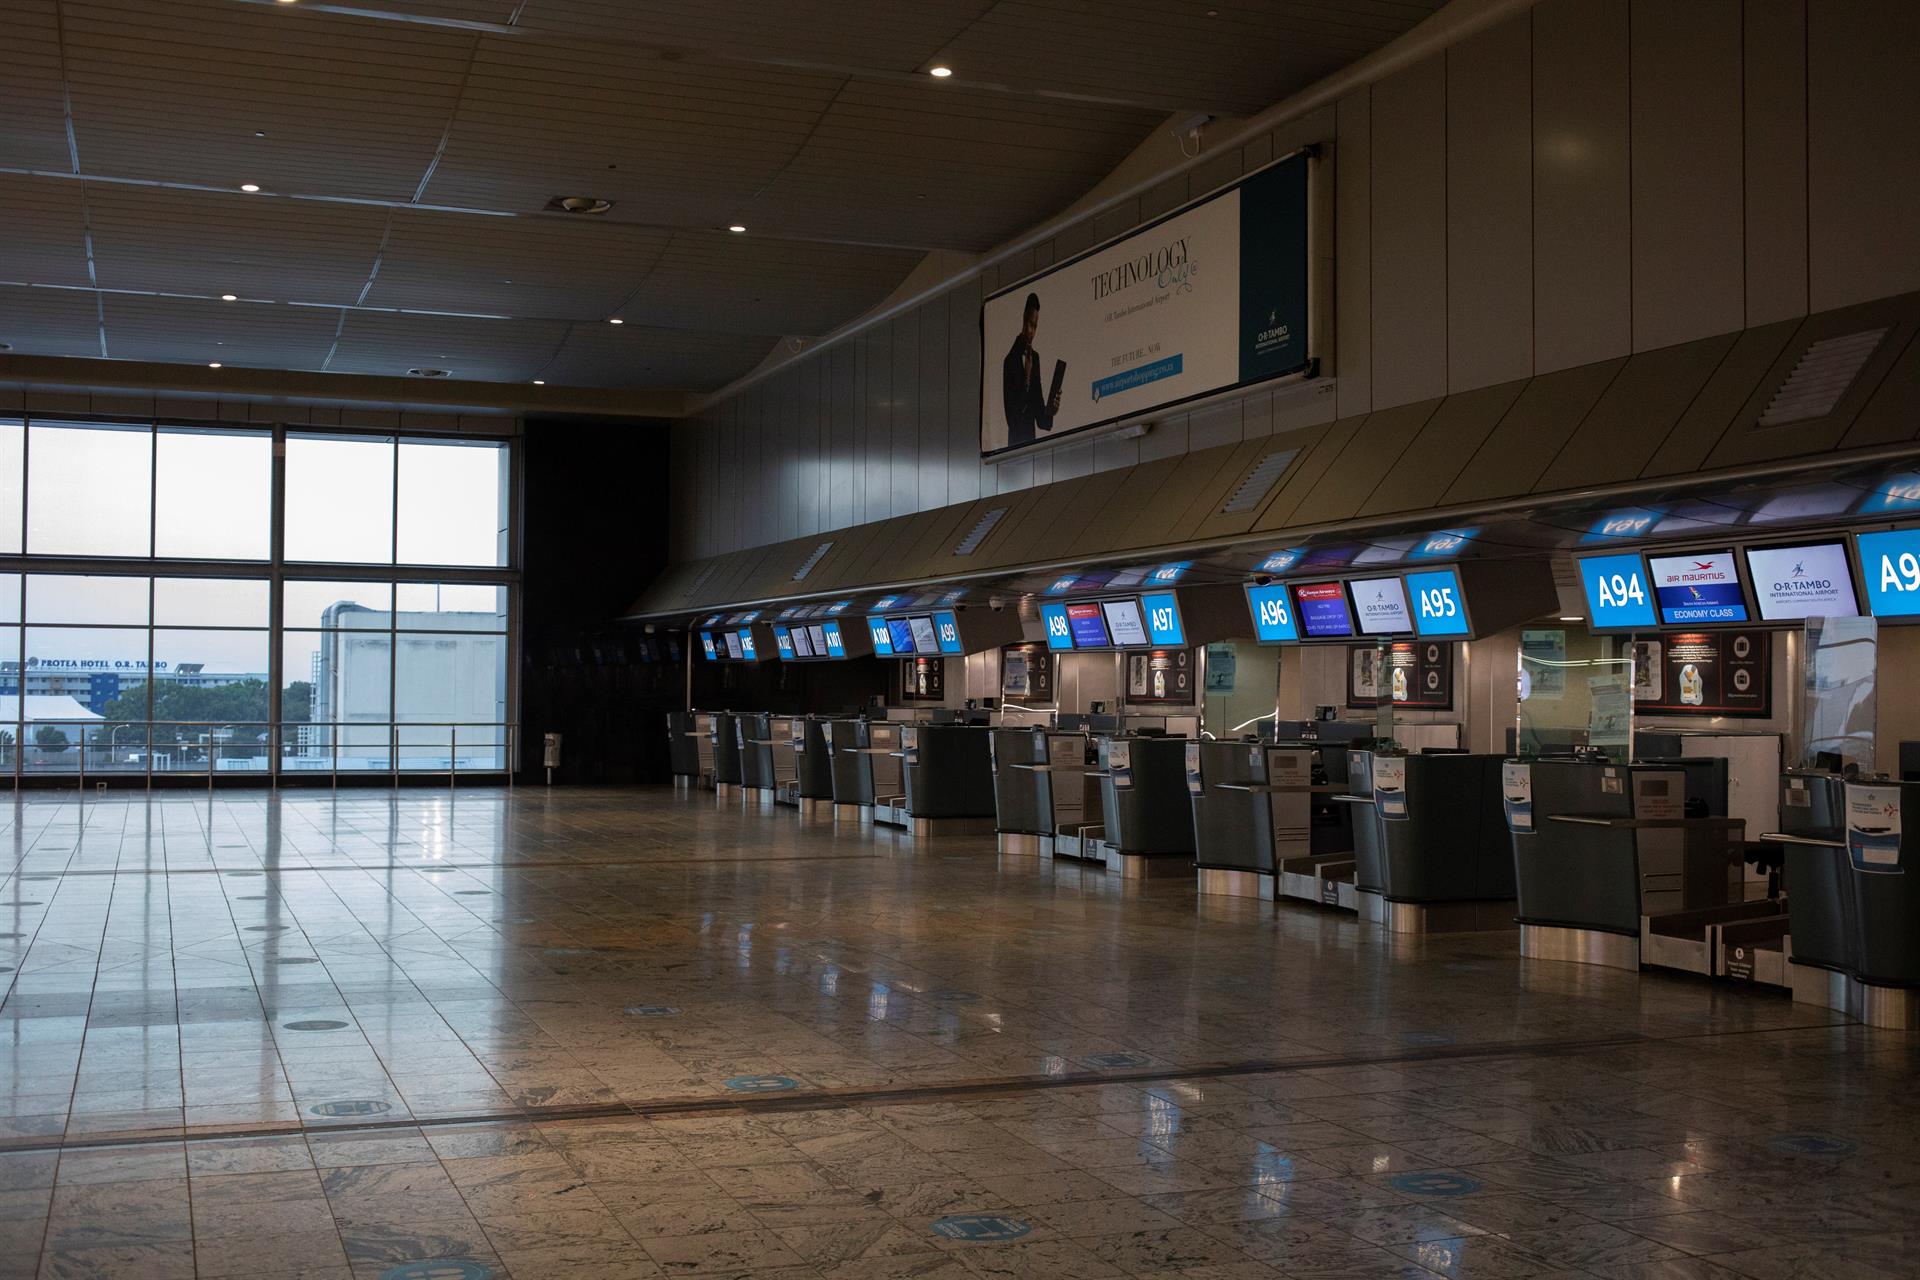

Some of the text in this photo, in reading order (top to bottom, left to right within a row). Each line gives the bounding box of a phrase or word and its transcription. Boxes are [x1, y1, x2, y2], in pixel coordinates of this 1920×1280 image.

[1091, 236, 1191, 301] TECHNOLOGY
[1881, 553, 1920, 593] A9
[1600, 573, 1644, 608] A94
[1770, 588, 1839, 598] INTERNATIONAL AIRPORT
[1260, 600, 1288, 625] A96
[1421, 588, 1456, 618] A95
[1674, 608, 1734, 619] ECONOMY CLASS
[1049, 615, 1068, 636] A98
[1152, 608, 1174, 631] A97
[826, 632, 842, 648] A101
[873, 628, 890, 645] A100
[940, 624, 956, 642] A99
[41, 659, 77, 667] PROTEA
[80, 660, 109, 668] HOTEL
[136, 661, 168, 669] TABO
